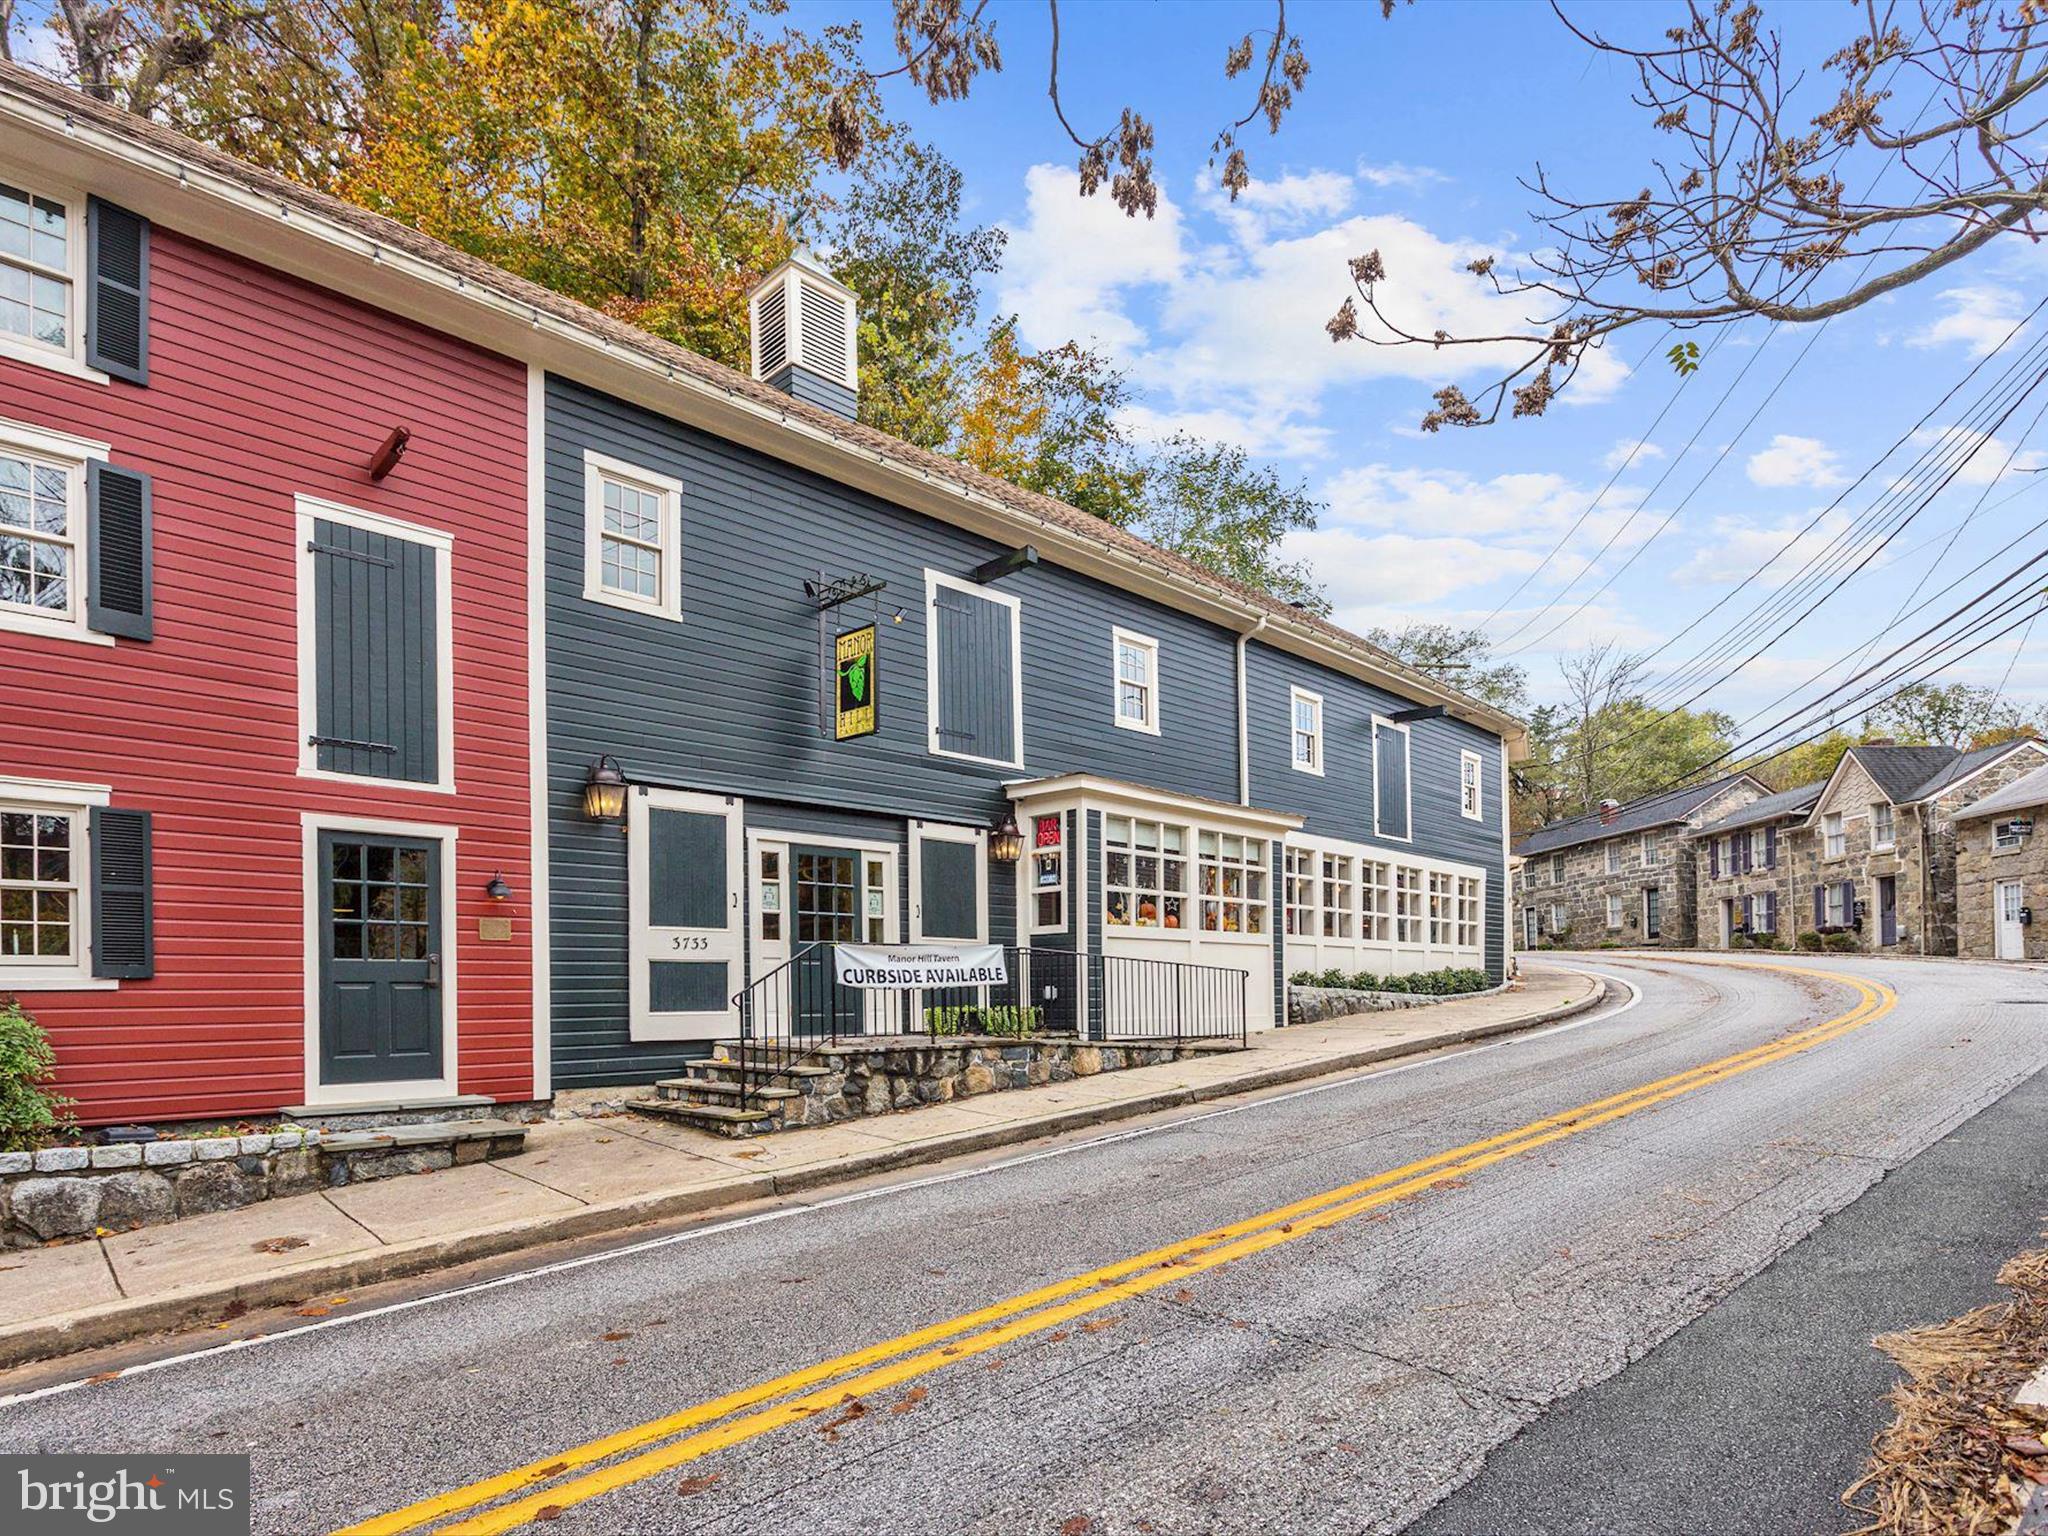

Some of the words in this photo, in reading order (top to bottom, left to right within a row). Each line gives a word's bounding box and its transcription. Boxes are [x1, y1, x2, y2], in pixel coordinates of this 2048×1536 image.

[838, 632, 873, 661] MANOR
[839, 707, 872, 728] HILL
[1039, 818, 1057, 832] BAR
[1037, 831, 1060, 847] OPEN
[672, 936, 708, 950] 3733
[888, 954, 916, 963] Manor
[918, 954, 932, 963] Hill
[933, 954, 960, 963] Tavern
[843, 968, 923, 984] CURBSIDE
[926, 967, 1004, 983] AVAILABLE
